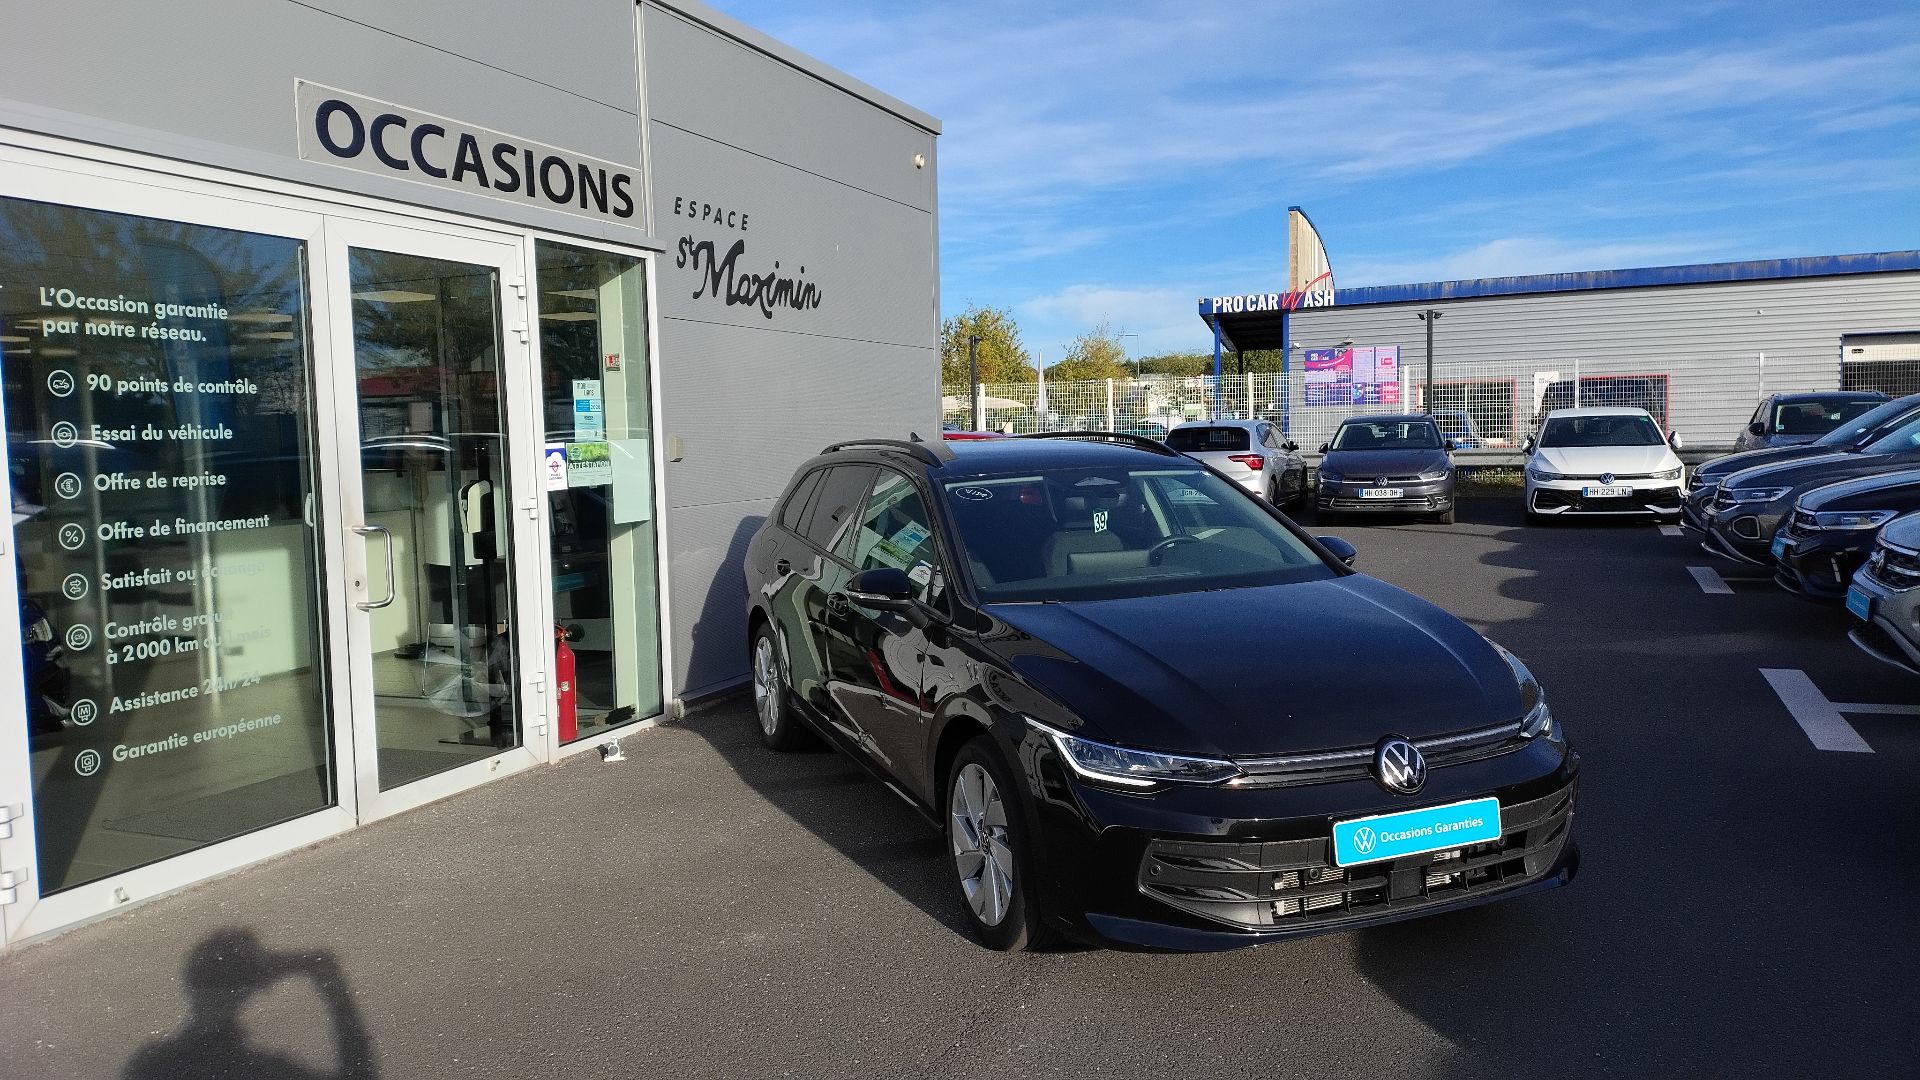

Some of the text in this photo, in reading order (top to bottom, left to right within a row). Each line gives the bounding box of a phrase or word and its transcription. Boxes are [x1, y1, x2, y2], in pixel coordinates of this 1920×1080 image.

[315, 99, 634, 218] OCCASIONS
[674, 197, 749, 231] ESPACE
[692, 239, 822, 319] Maximin
[1212, 274, 1335, 313] PRO CAR WASH
[154, 301, 228, 320] garantie
[43, 320, 207, 341] par notre réseau.
[86, 374, 257, 395] 90 points de contrôle
[91, 423, 233, 441] Essai du véhicule
[94, 471, 226, 491] Offre de reprise
[98, 515, 269, 541] Offre de financement
[1095, 512, 1106, 531] 39
[101, 568, 171, 591] Satisfait
[176, 570, 196, 581] ou
[104, 615, 177, 639] Contrôle
[106, 649, 117, 665] à
[175, 637, 198, 653] km
[109, 686, 198, 714] Assistance
[112, 713, 281, 762] Garantie européenne
[1380, 827, 1433, 843] Occasions
[1435, 816, 1483, 834] Garanties
